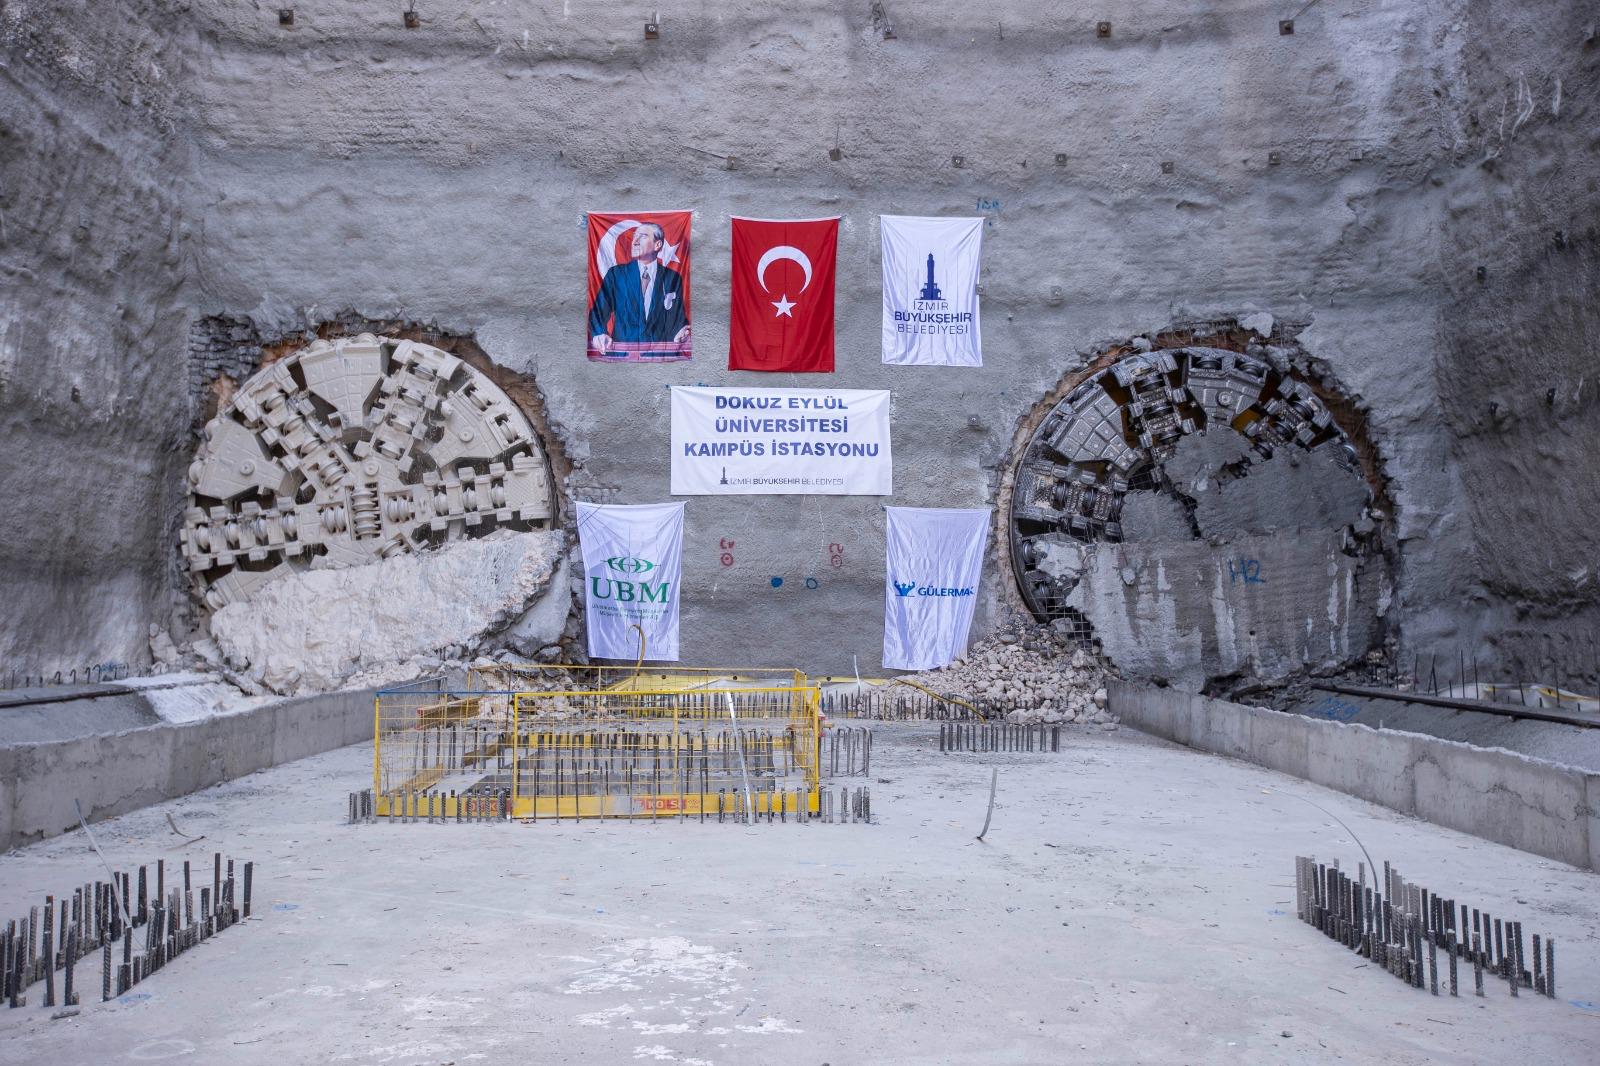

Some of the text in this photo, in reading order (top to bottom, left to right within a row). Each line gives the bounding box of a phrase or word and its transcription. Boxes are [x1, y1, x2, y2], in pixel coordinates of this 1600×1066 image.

[894, 311, 972, 324] BÜYÜKŞEHİR
[897, 324, 968, 335] BELEDİYESİ
[715, 396, 849, 410] DOKUZ EYLÜL
[715, 416, 848, 433] ÜNİVERSİTESİ
[684, 439, 879, 457] KAMPÜS İSTASYONU
[590, 576, 670, 604] UBM
